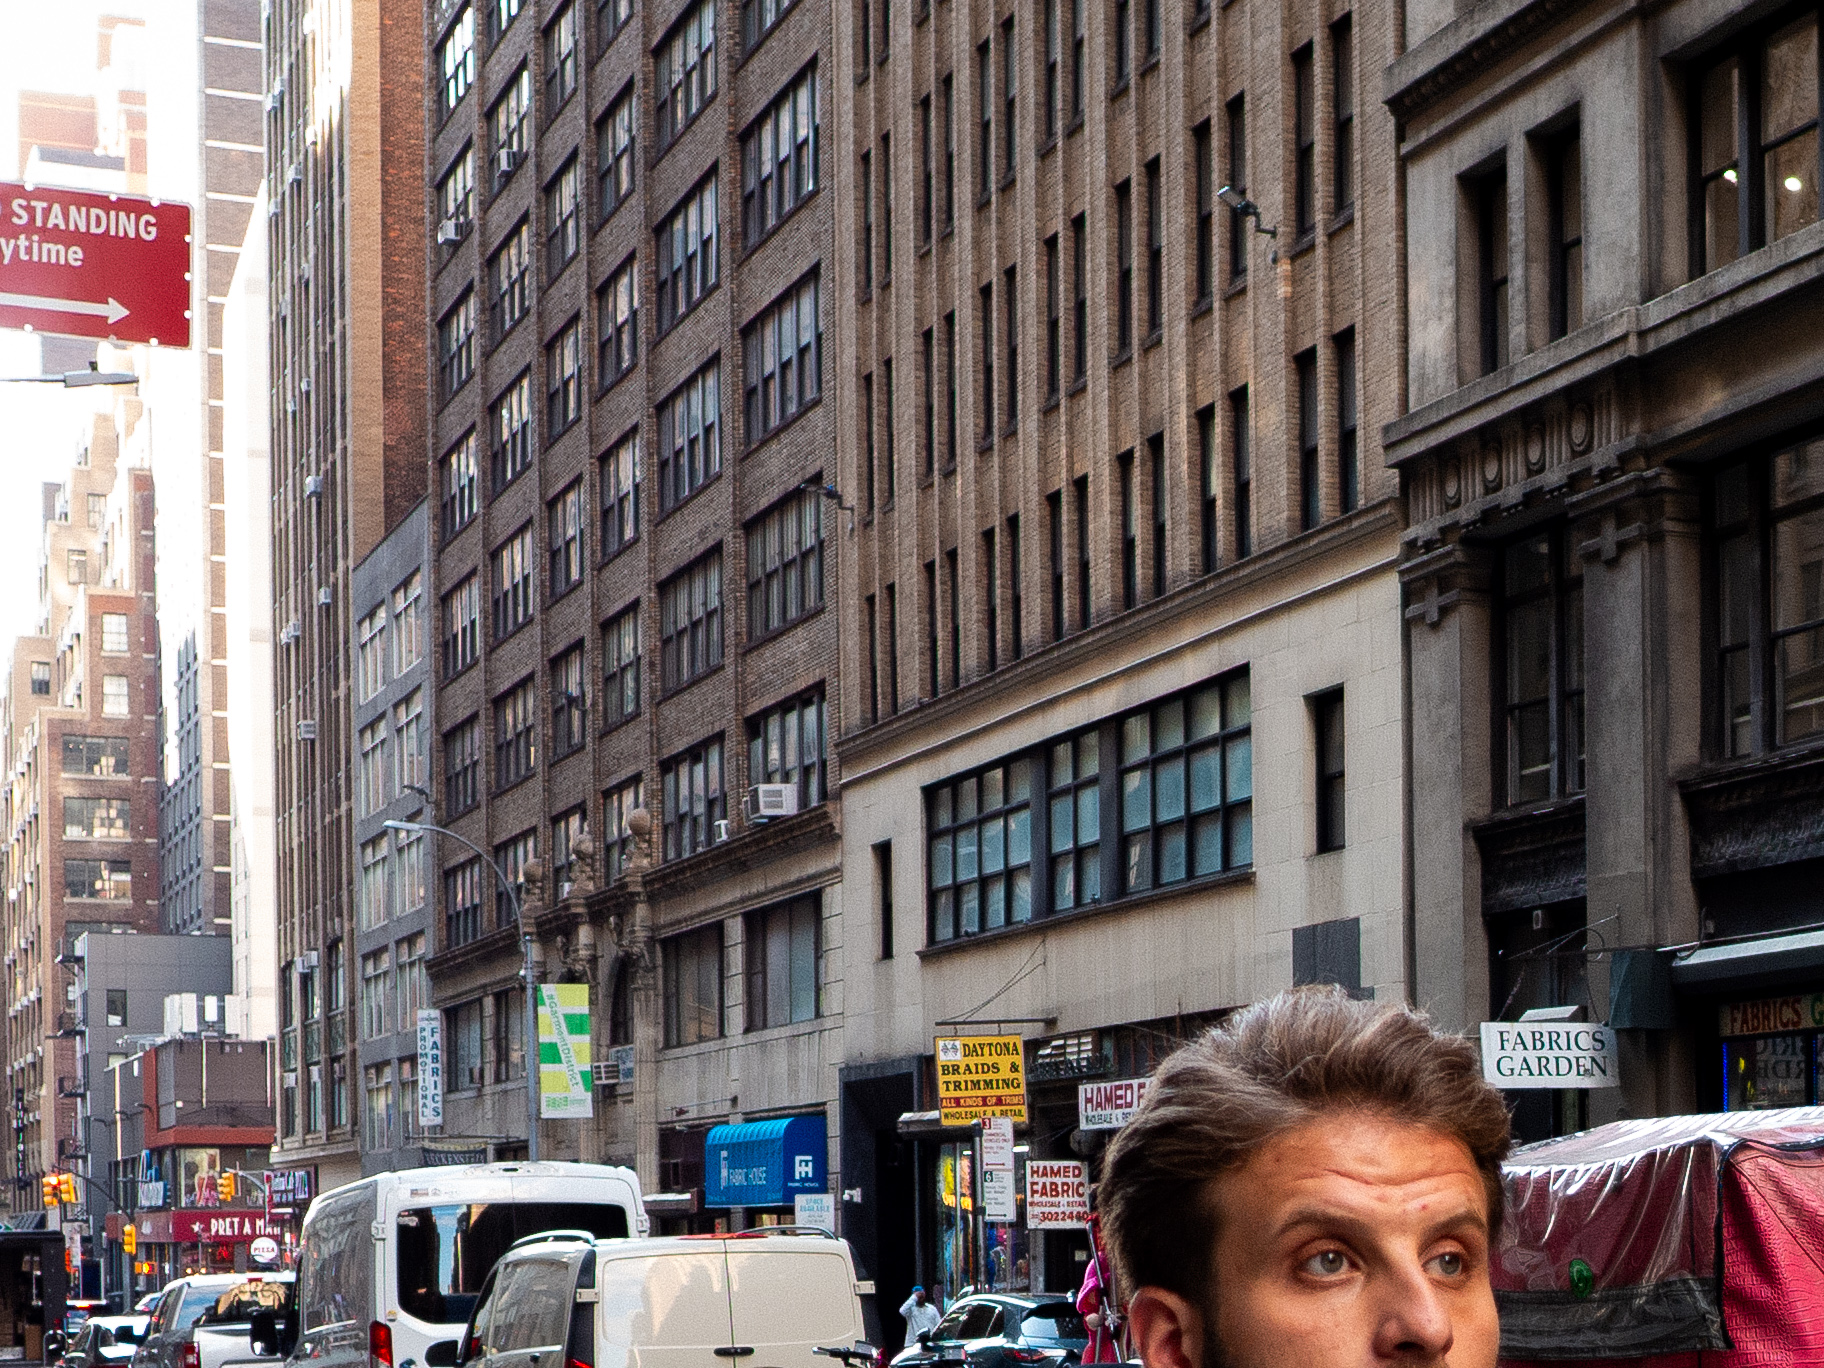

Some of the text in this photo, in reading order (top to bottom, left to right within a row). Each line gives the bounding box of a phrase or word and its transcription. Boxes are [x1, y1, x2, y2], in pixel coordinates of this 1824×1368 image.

[11, 198, 157, 241] STANDING
[1730, 997, 1802, 1034] FABRICS
[963, 1042, 1020, 1058] DAYTONA
[1497, 1030, 1606, 1052] FABRICS
[419, 1026, 428, 1118] PROMOTIONAL
[430, 1026, 441, 1118] FABRICS
[940, 1061, 1020, 1076] BRAIDS &
[1496, 1055, 1608, 1077] GARDEN
[942, 1077, 1022, 1092] TRIMMING
[941, 1095, 1024, 1108] ALL KINDS OF TRIMS
[1084, 1083, 1134, 1113] HAMED
[943, 1110, 988, 1121] WHOLESALE
[1030, 1165, 1083, 1178] HAMED
[1029, 1181, 1086, 1199] FABRIC
[210, 1217, 240, 1236] PRET
[242, 1217, 252, 1236] A
